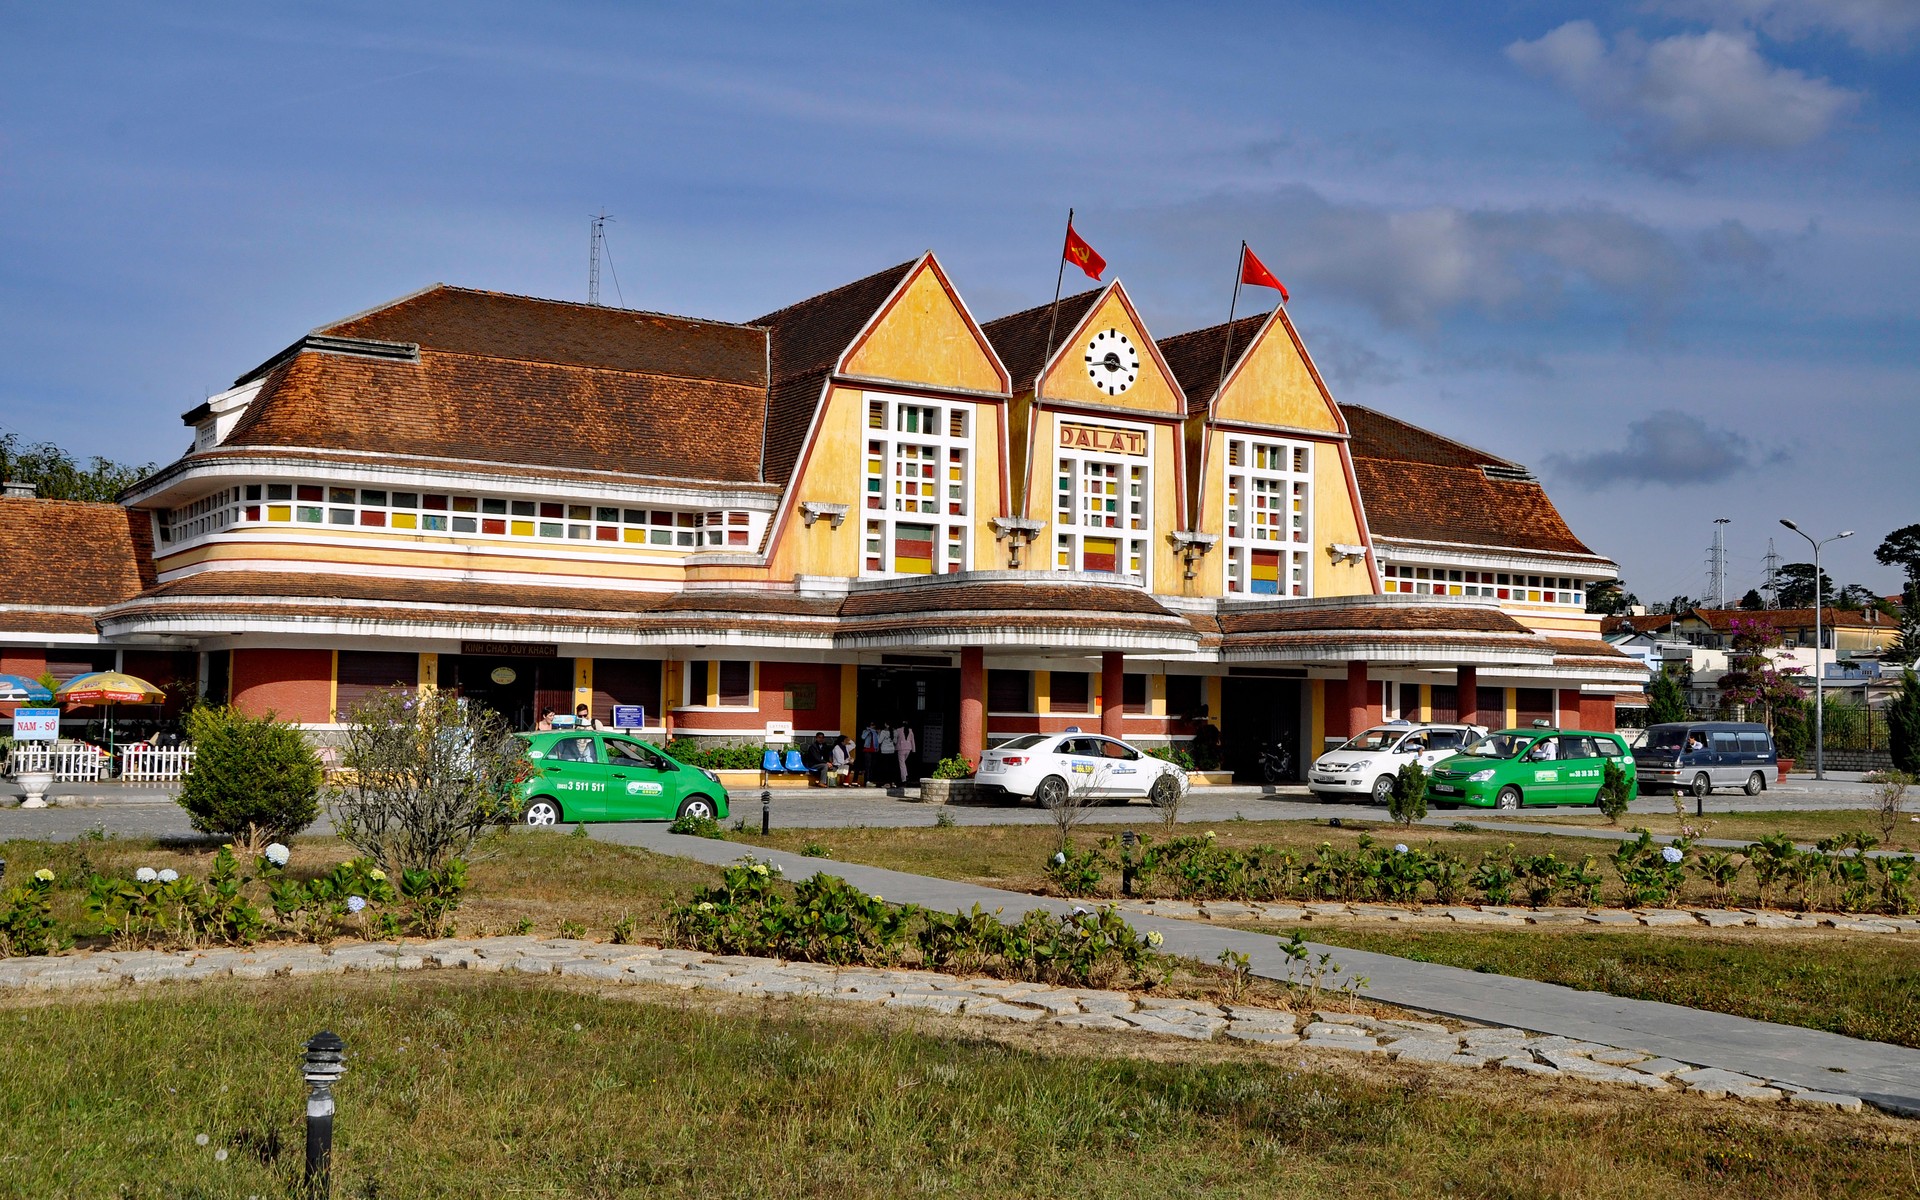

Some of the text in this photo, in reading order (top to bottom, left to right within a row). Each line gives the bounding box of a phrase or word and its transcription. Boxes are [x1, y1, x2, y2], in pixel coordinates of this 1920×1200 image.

[17, 721, 36, 731] NAM
[575, 782, 589, 791] 511
[591, 783, 605, 792] 511
